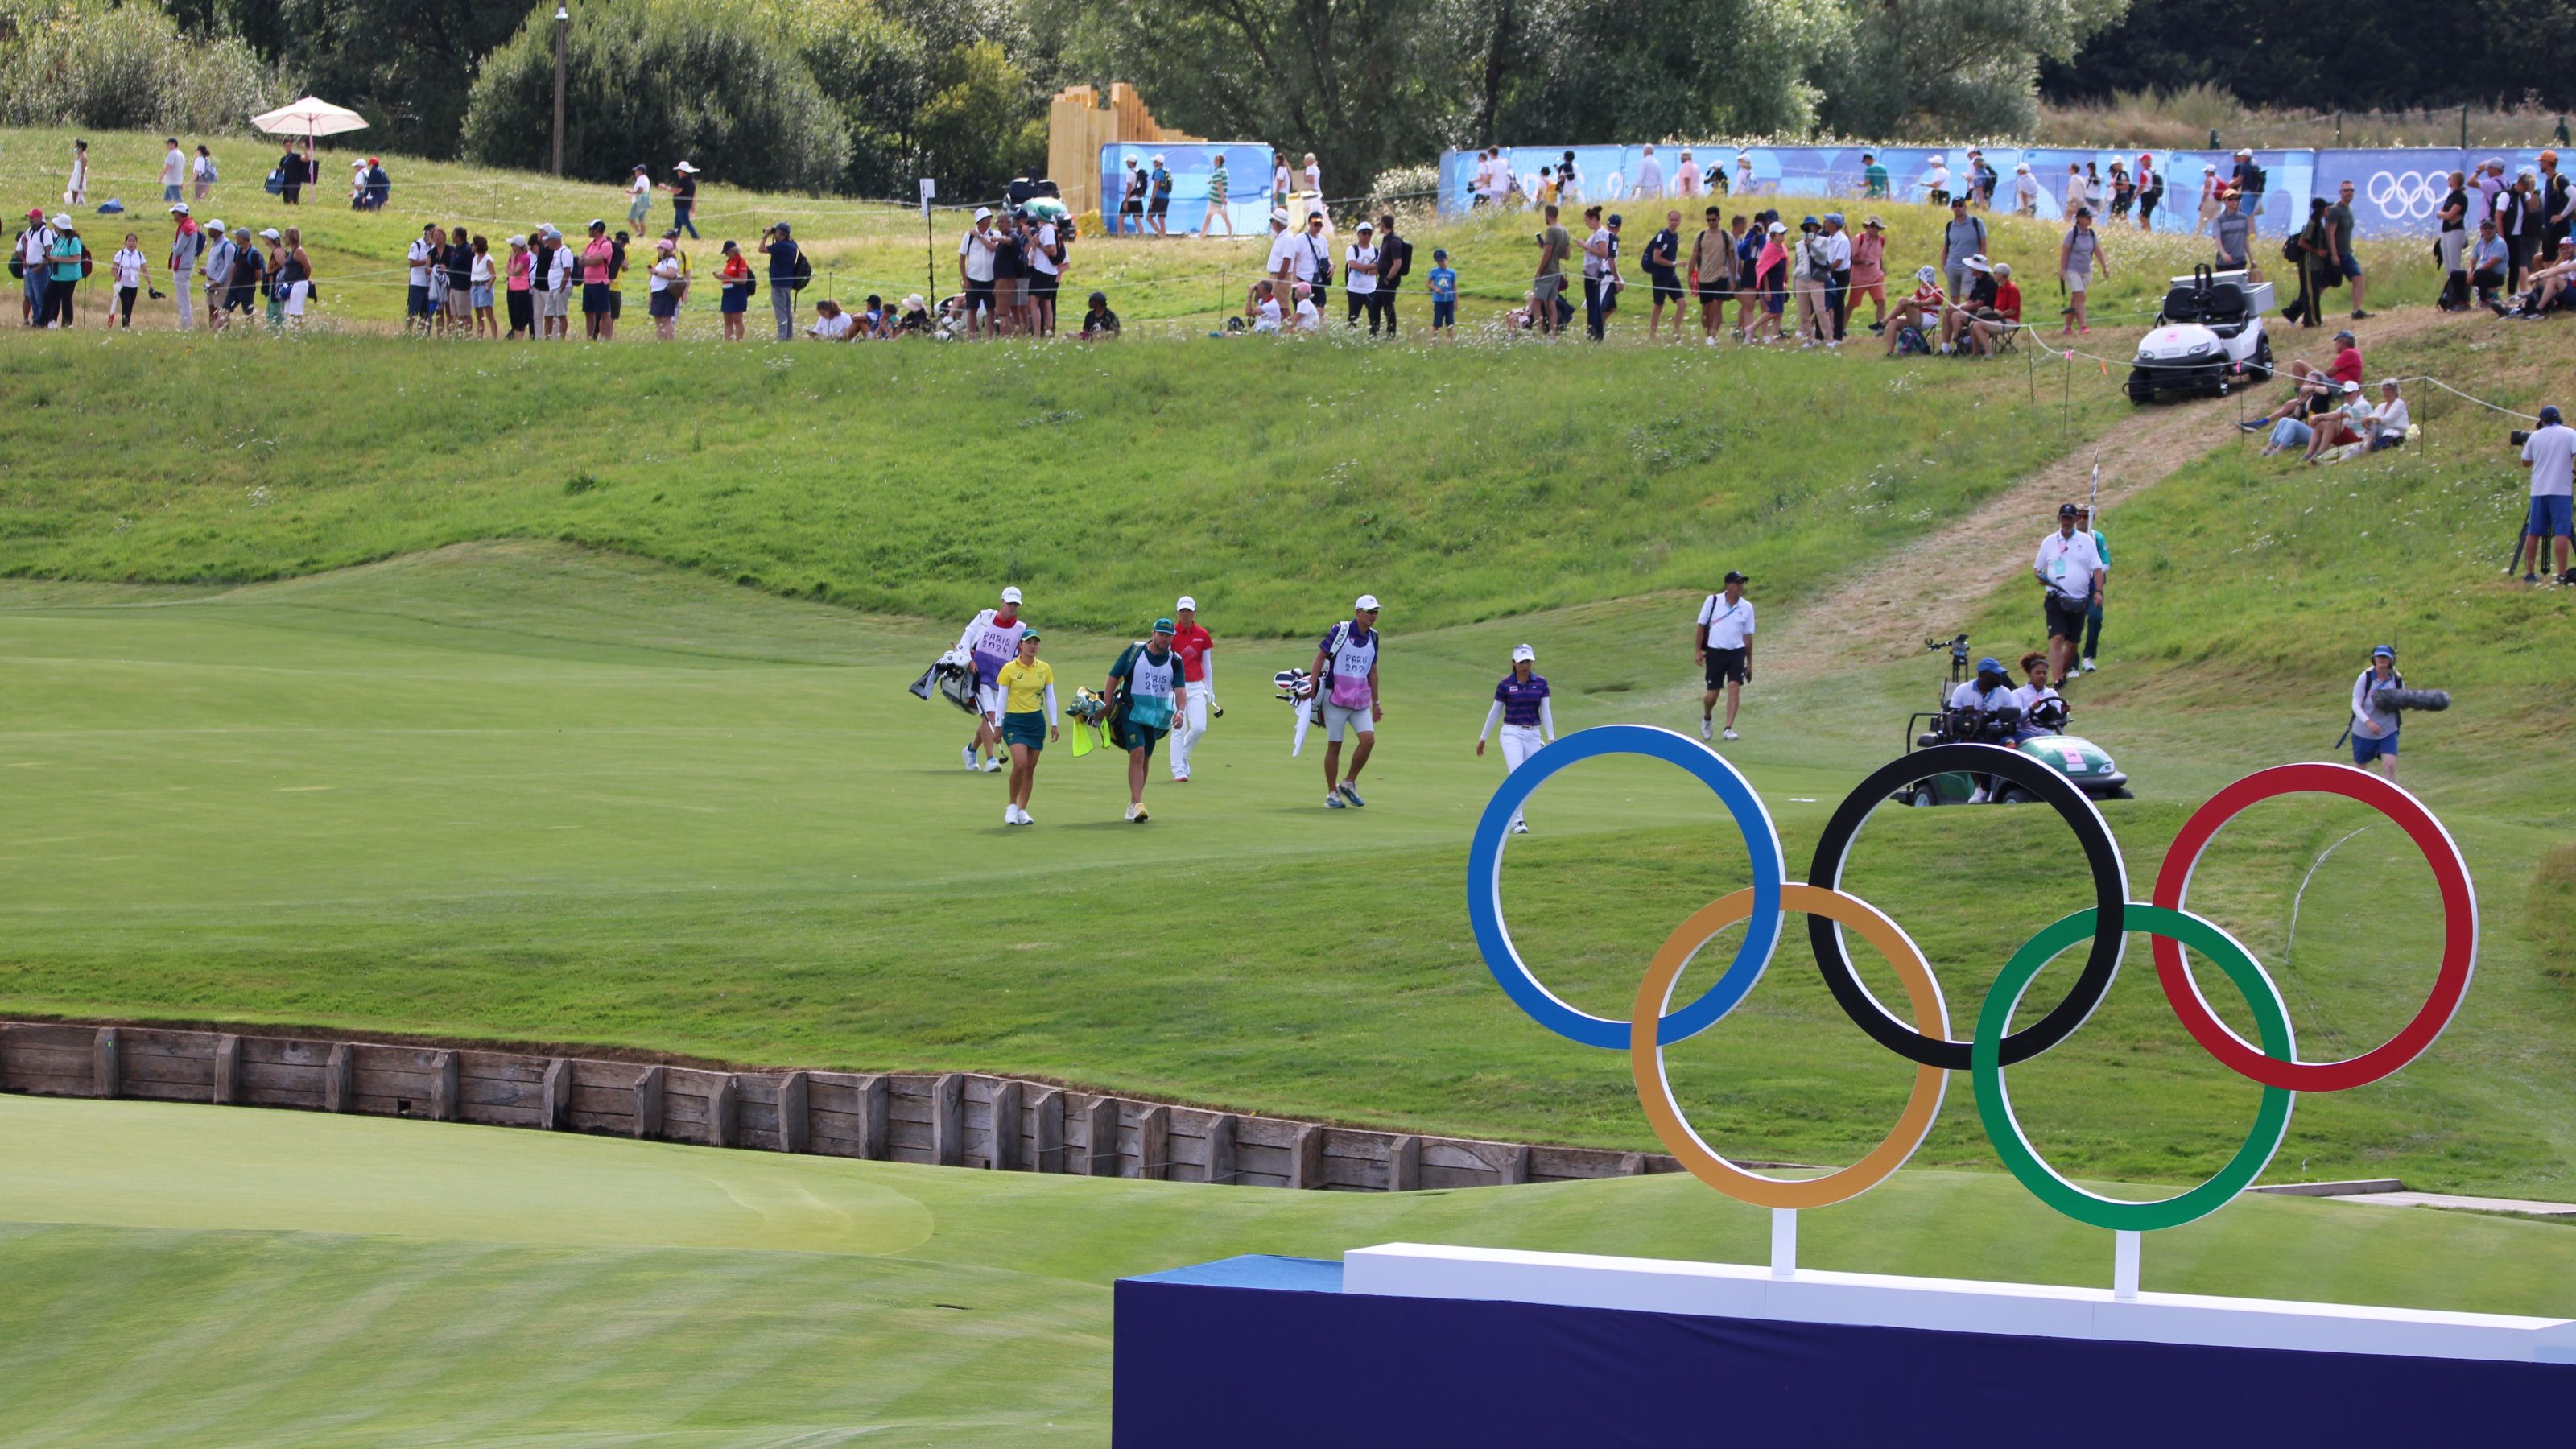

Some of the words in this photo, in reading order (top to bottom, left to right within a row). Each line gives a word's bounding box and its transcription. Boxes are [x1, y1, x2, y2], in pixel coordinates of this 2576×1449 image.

[983, 631, 1011, 646] PARIS
[982, 640, 1008, 654] 2024
[1145, 672, 1167, 684] PRIS
[1145, 681, 1165, 693] 224
